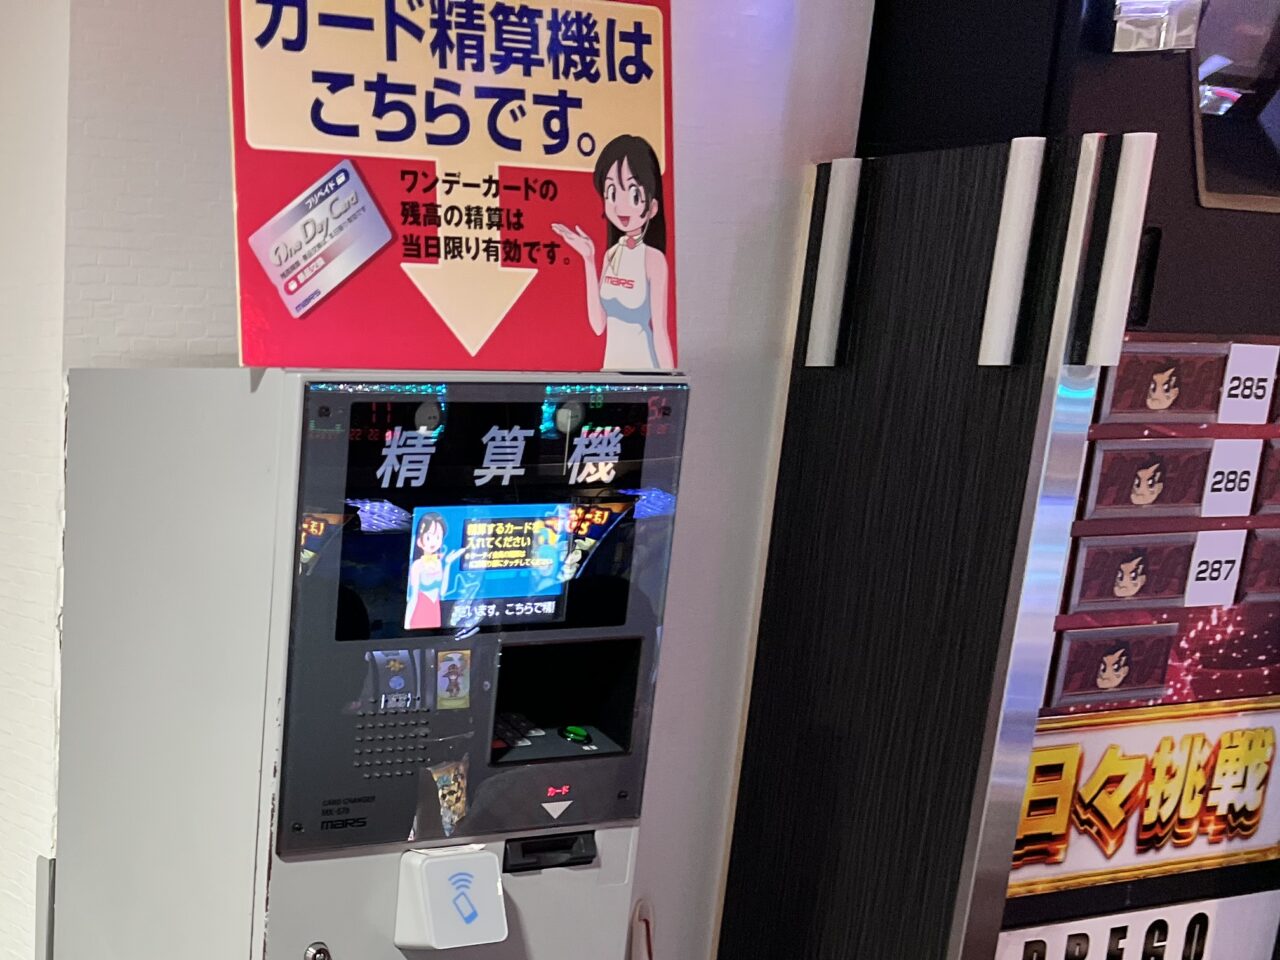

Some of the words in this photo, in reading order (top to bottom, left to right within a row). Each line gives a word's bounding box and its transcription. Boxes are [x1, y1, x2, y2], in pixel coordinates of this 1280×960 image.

[255, 0, 653, 84] カード精算機は
[310, 71, 596, 156] こちらです。
[401, 170, 557, 201] ワンデーカードの
[401, 201, 524, 231] 残高の精算は
[402, 233, 570, 266] 当日限り有効です。
[1227, 376, 1268, 400] 285
[376, 425, 624, 489] 精算機
[1210, 470, 1251, 493] 286
[1194, 560, 1237, 582] 287
[547, 785, 570, 797] カード
[1014, 728, 1276, 856] 日々挑戦
